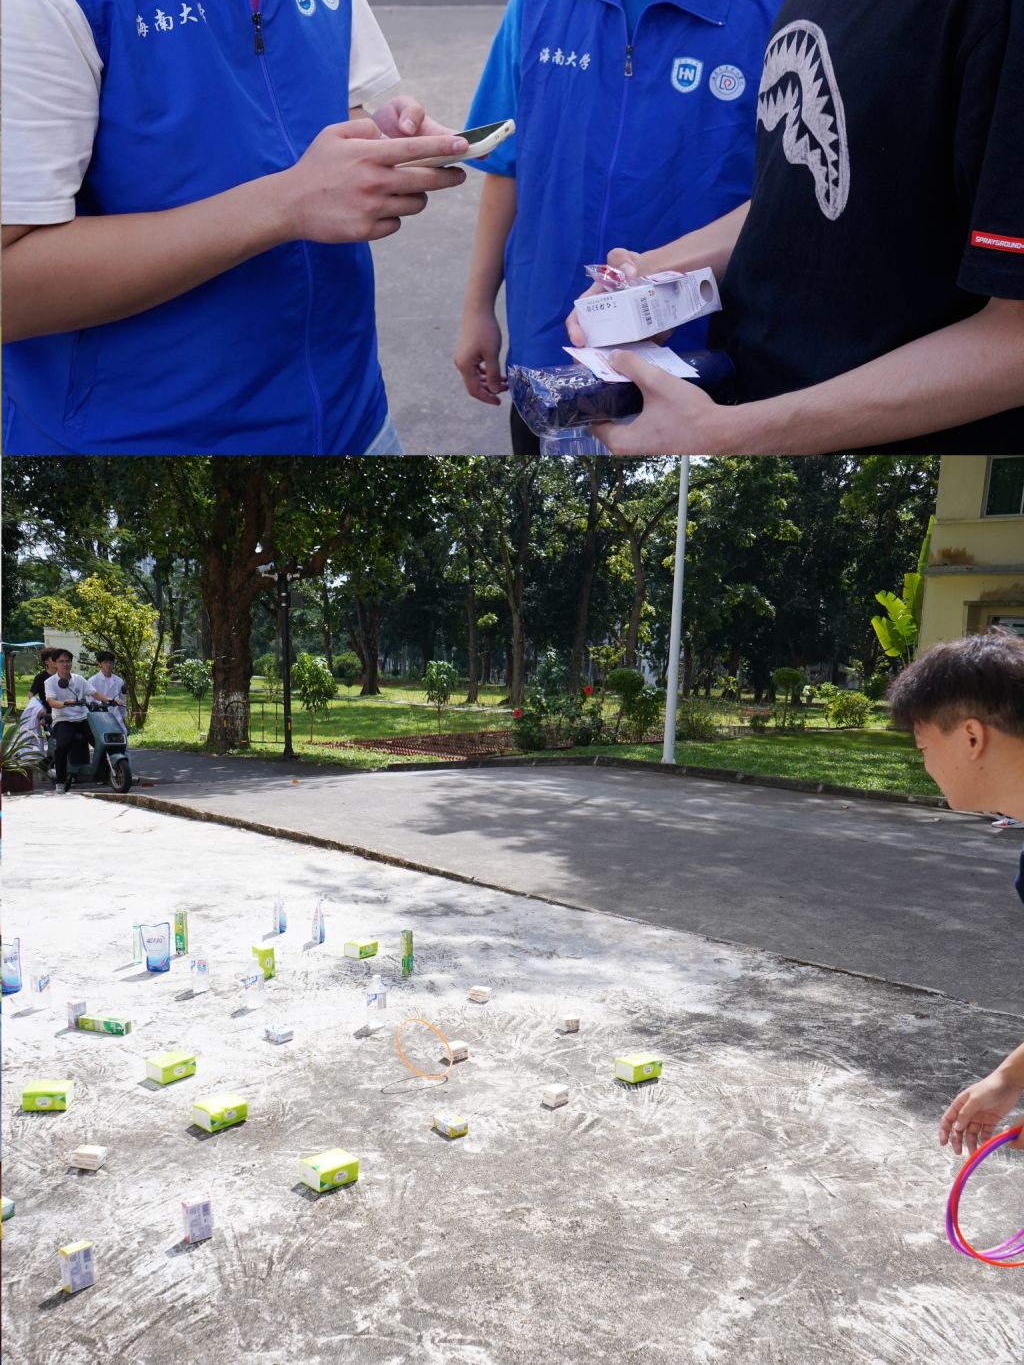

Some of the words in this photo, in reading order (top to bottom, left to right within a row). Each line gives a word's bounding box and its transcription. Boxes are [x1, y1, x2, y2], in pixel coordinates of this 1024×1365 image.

[539, 47, 592, 71] 海南大学
[678, 66, 695, 82] HN
